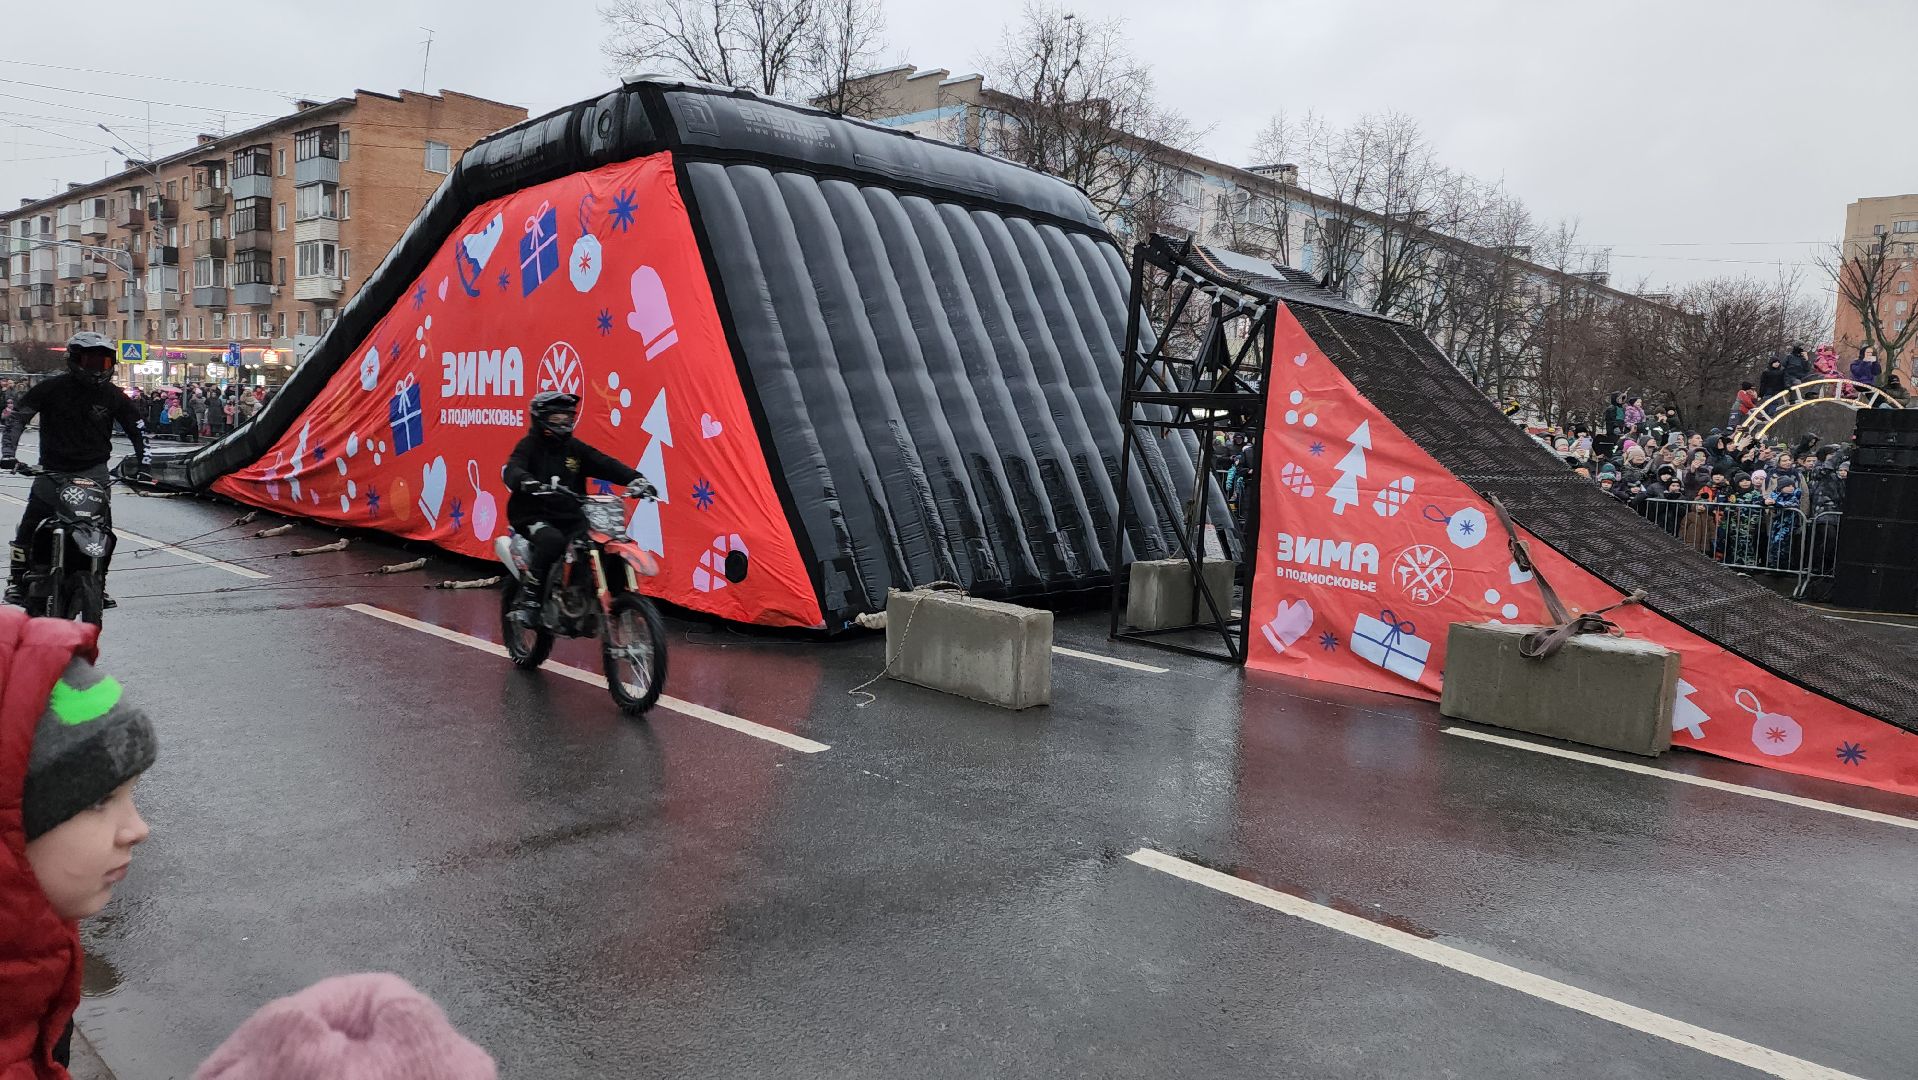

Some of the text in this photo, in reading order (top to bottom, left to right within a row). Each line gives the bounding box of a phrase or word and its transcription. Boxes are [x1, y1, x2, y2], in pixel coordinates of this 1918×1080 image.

[441, 346, 524, 398] ЗИМА
[440, 408, 523, 428] В ПОДМОСКОВЬЕ
[1277, 532, 1380, 575] ЗИМА
[1276, 567, 1377, 593] В ПОДМОСКОВЬЕ
